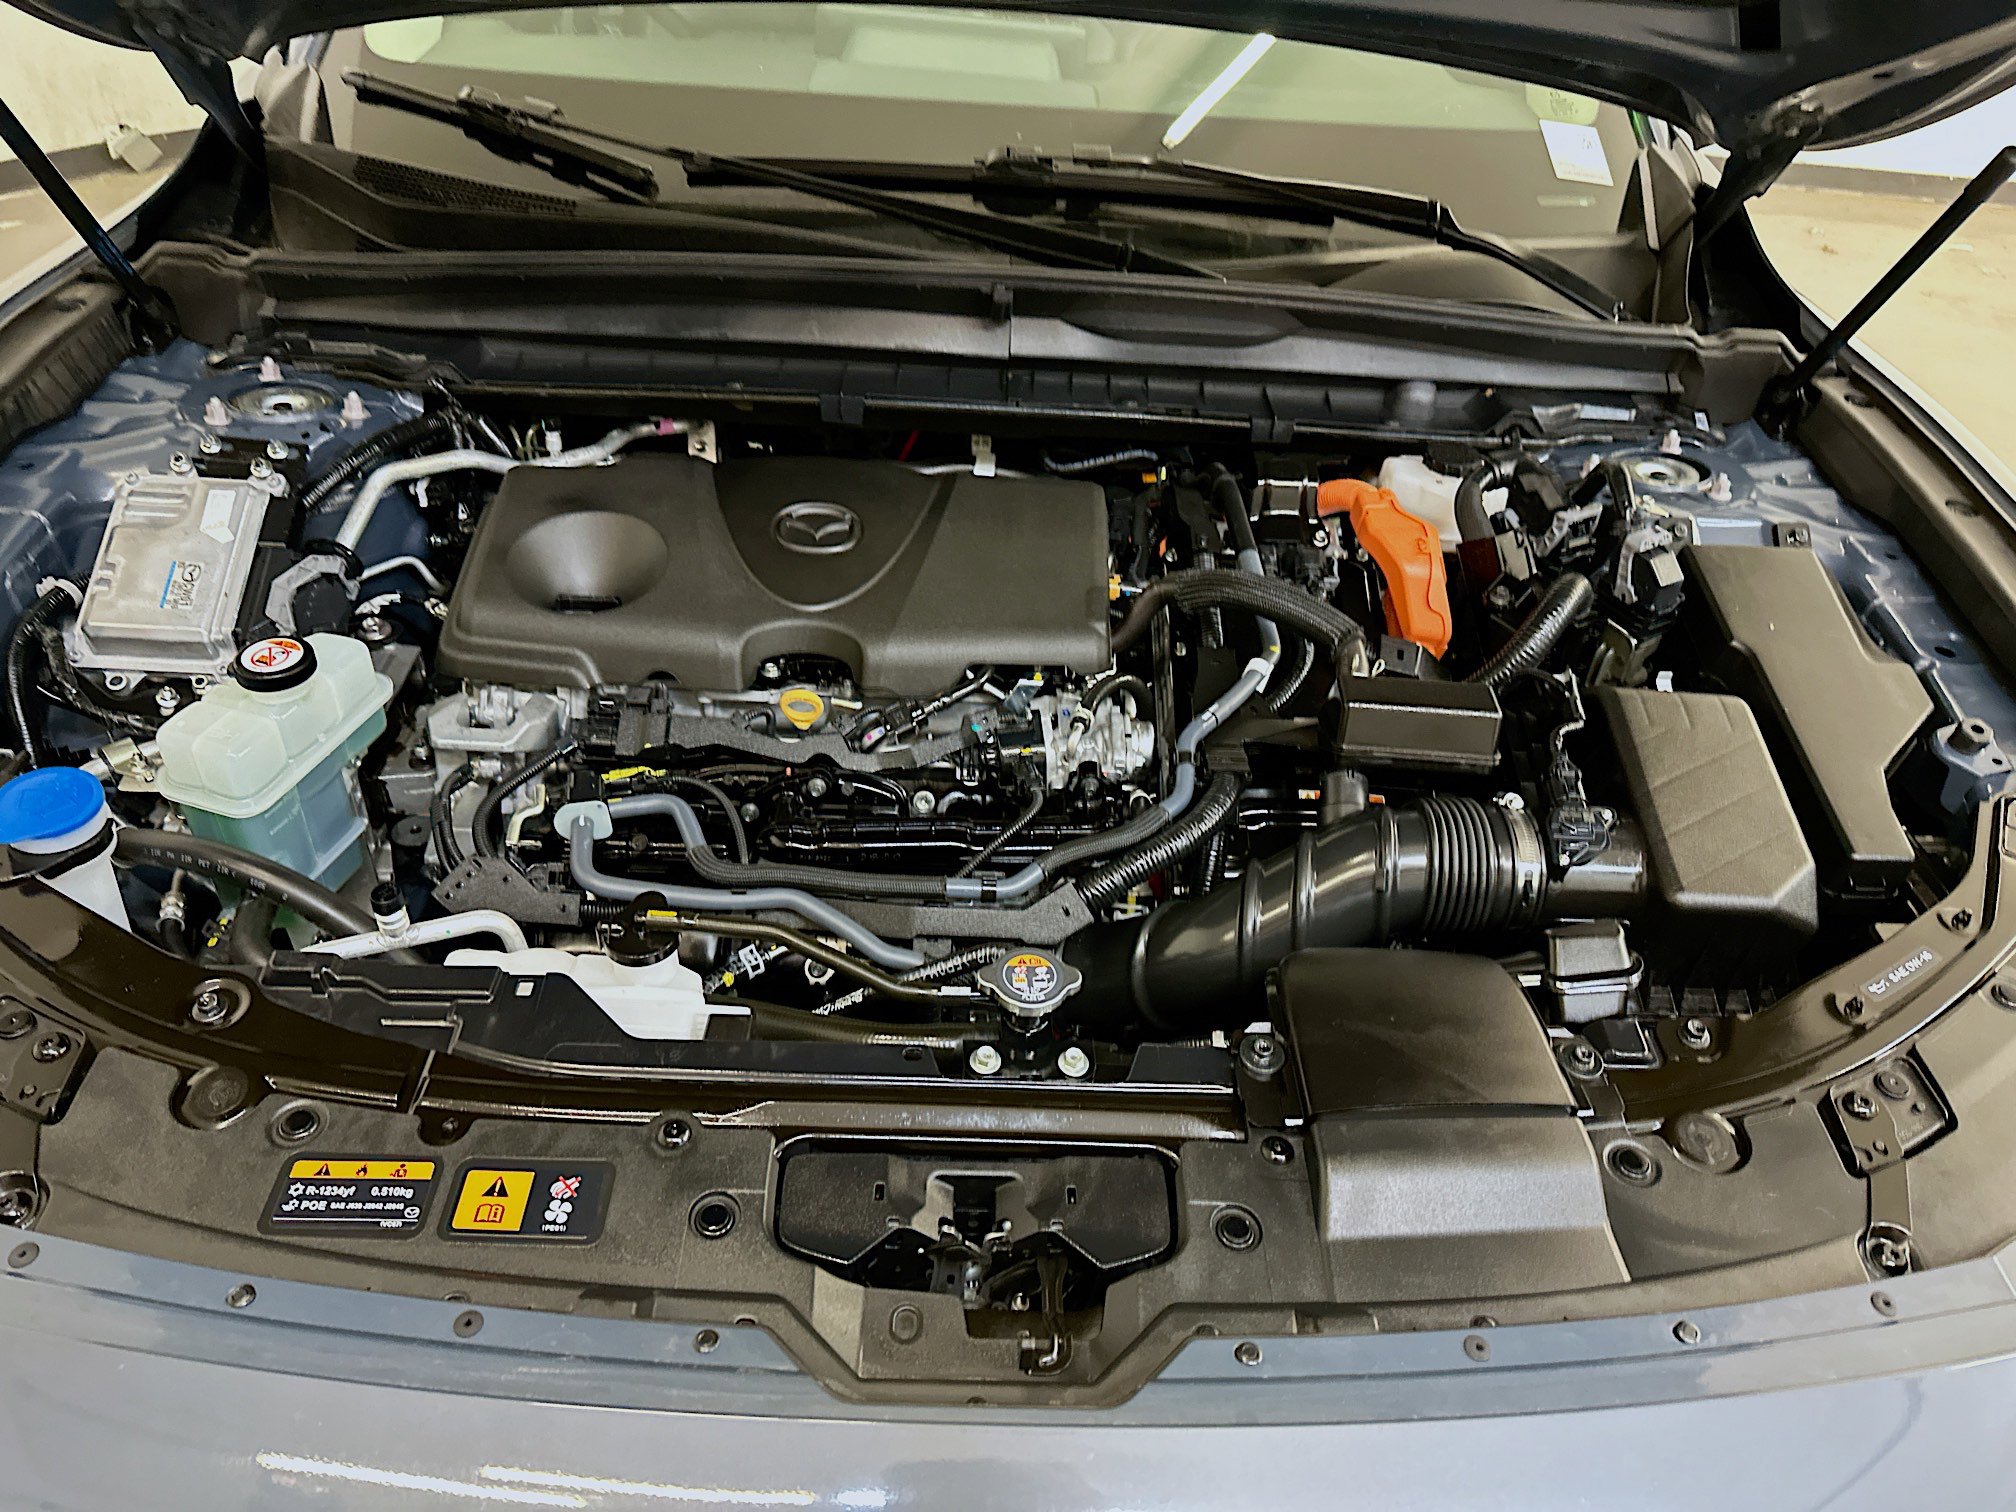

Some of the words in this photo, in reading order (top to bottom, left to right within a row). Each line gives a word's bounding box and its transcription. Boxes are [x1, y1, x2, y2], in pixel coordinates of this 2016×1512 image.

[1888, 965, 1910, 983] SAE
[305, 1185, 356, 1198] R-1234yf
[370, 1186, 413, 1199] 0.510kg
[300, 1200, 327, 1211] POE
